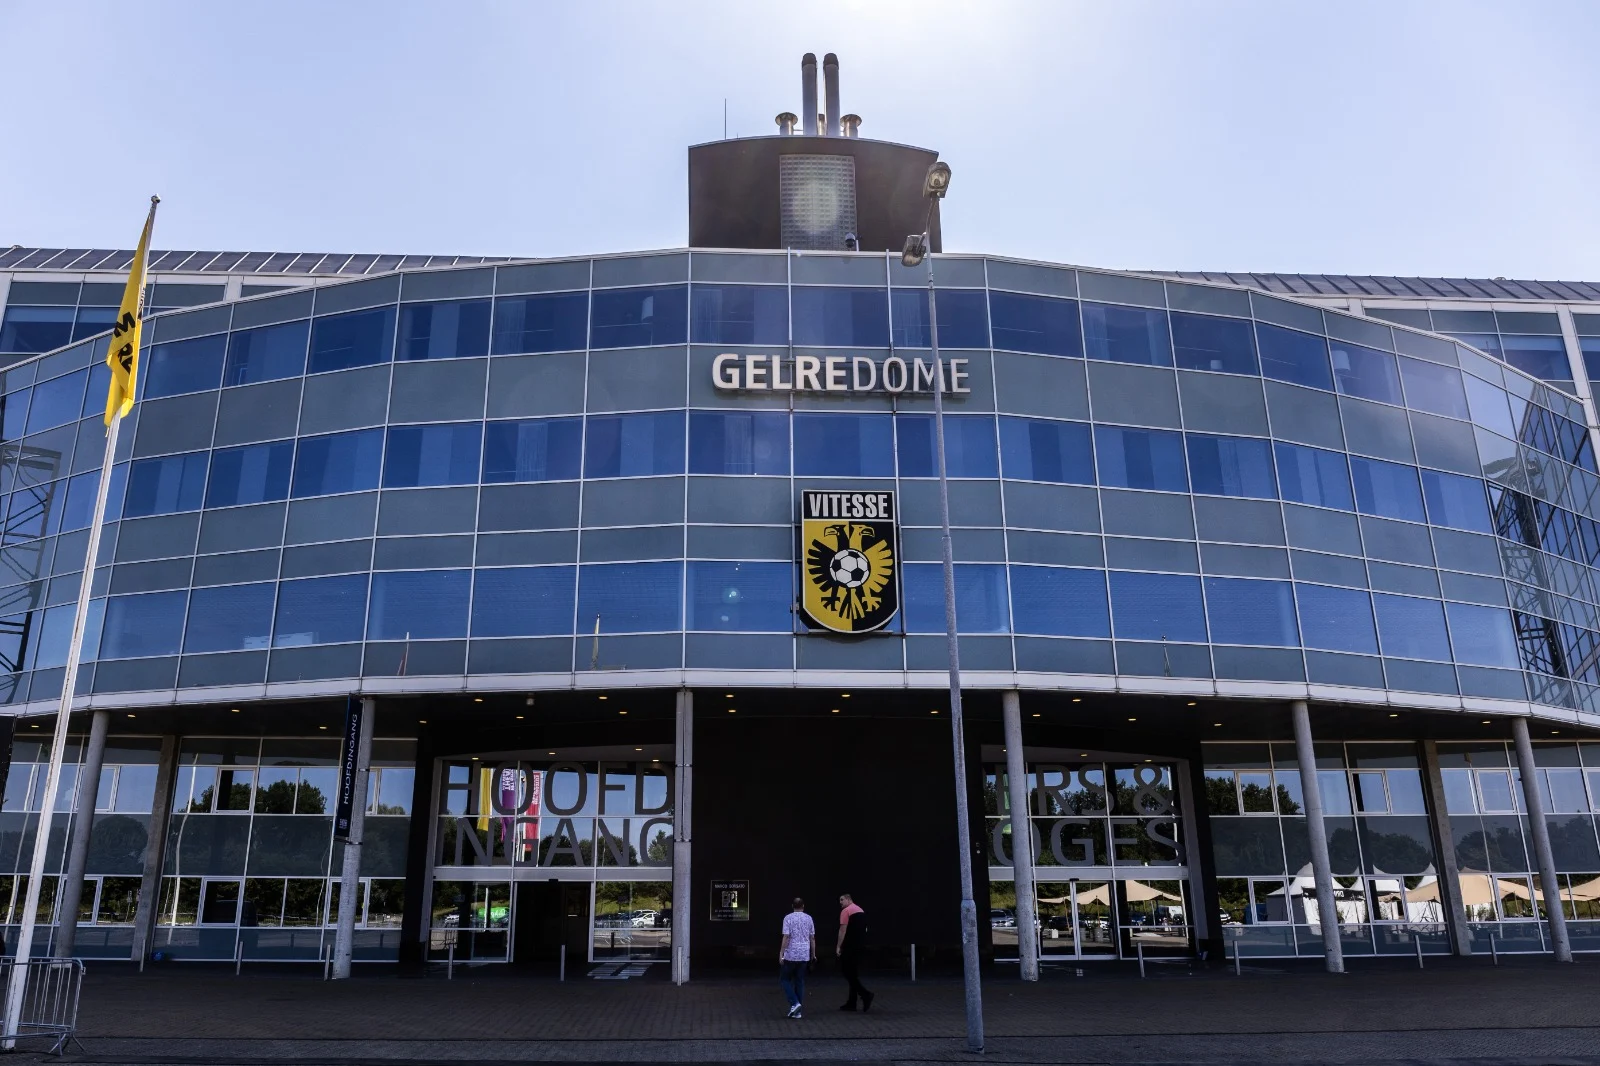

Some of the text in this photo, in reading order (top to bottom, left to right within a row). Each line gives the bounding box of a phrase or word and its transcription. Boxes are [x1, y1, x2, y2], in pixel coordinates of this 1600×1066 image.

[712, 353, 971, 394] GELREDOME
[809, 493, 889, 518] VITESSE
[343, 713, 358, 805] HOOFDINGANG
[439, 761, 674, 815] HOOFD
[1133, 763, 1181, 816] &
[435, 818, 673, 867] INGANG
